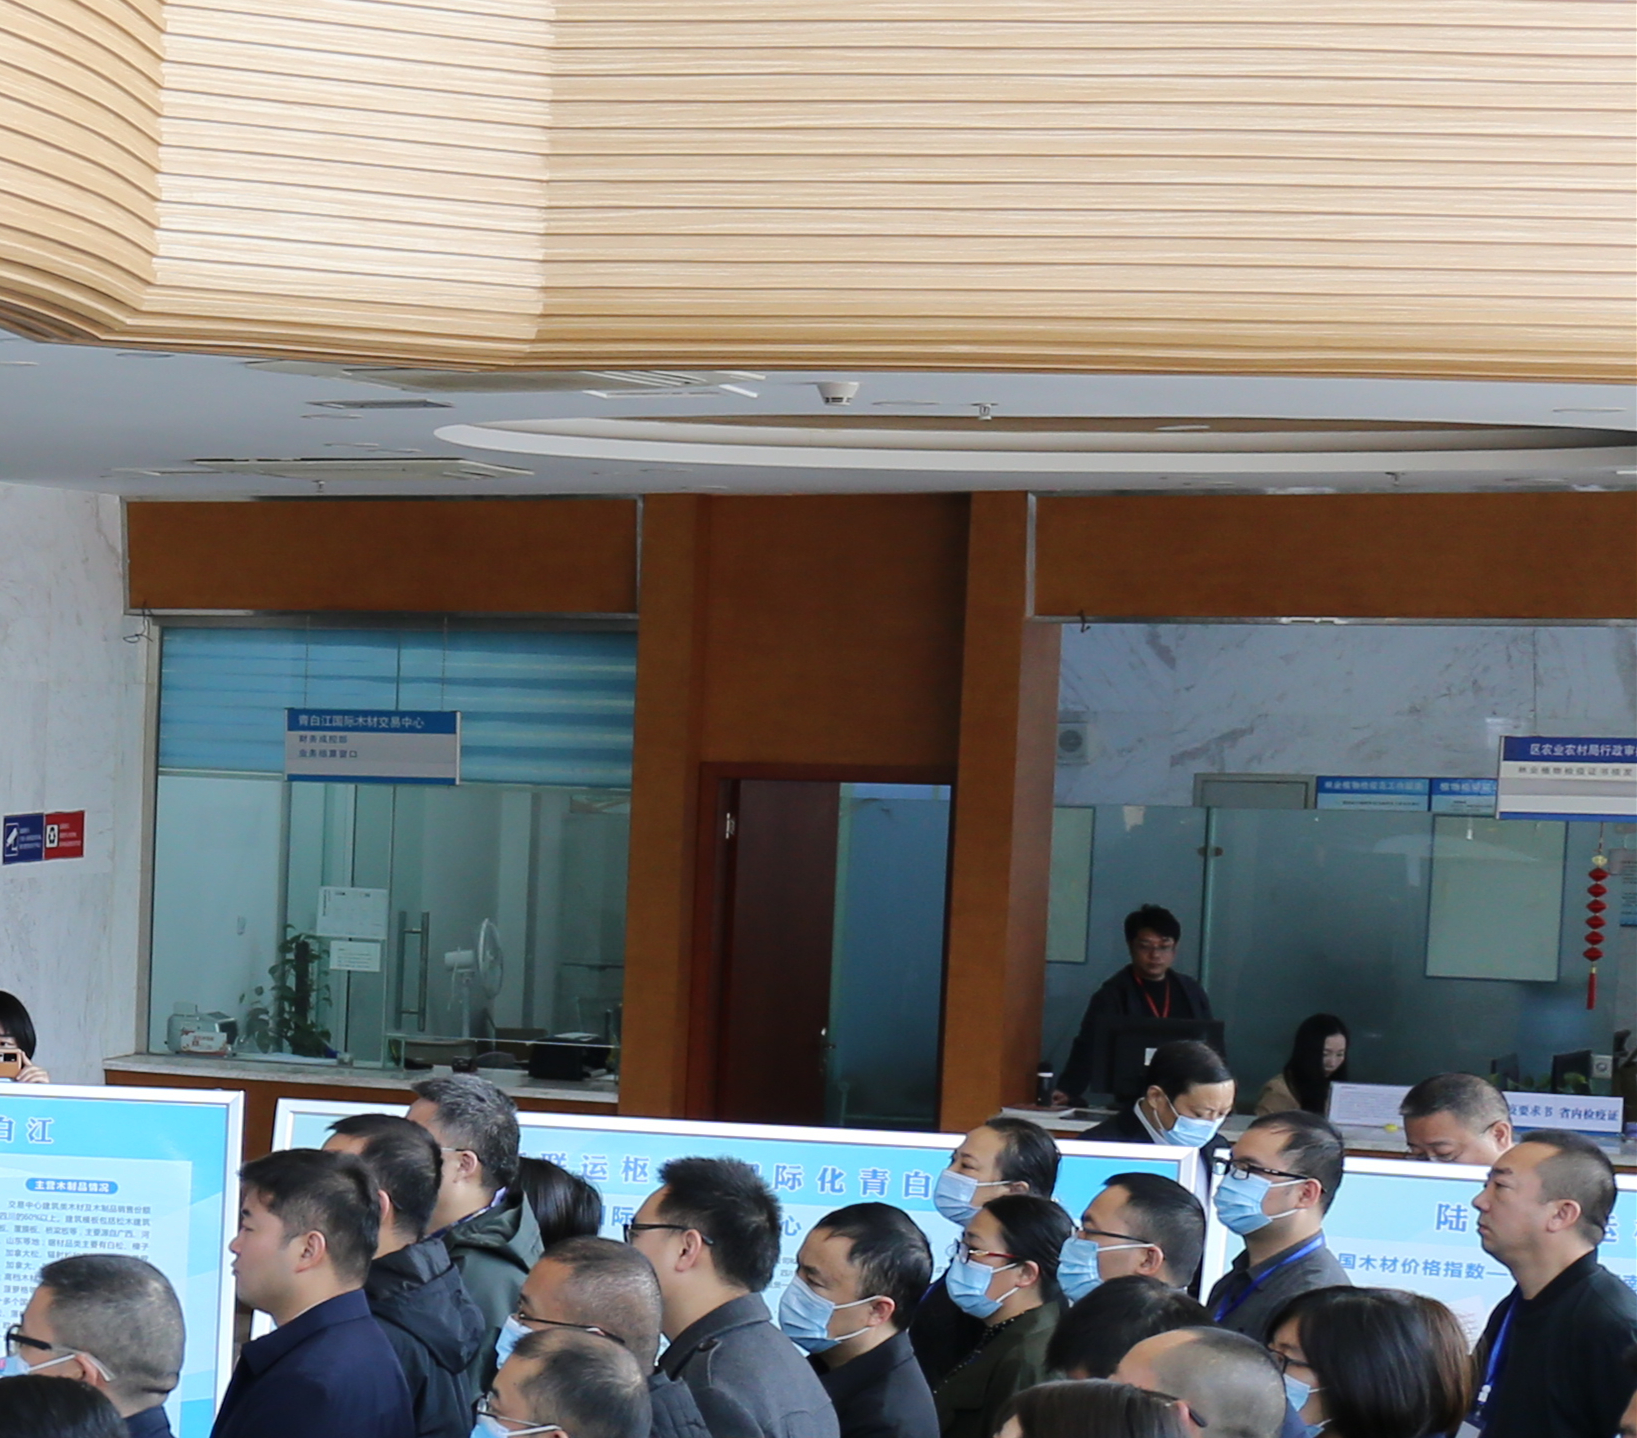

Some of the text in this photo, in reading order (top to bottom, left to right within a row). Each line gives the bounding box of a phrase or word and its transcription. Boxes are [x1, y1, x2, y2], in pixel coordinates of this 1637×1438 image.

[298, 714, 425, 729] 青白江国际木材交易中心
[1530, 743, 1637, 758] 区农业农村局行政审
[34, 1180, 110, 1193] 主营木制品情况
[747, 1163, 932, 1199] 际化青白
